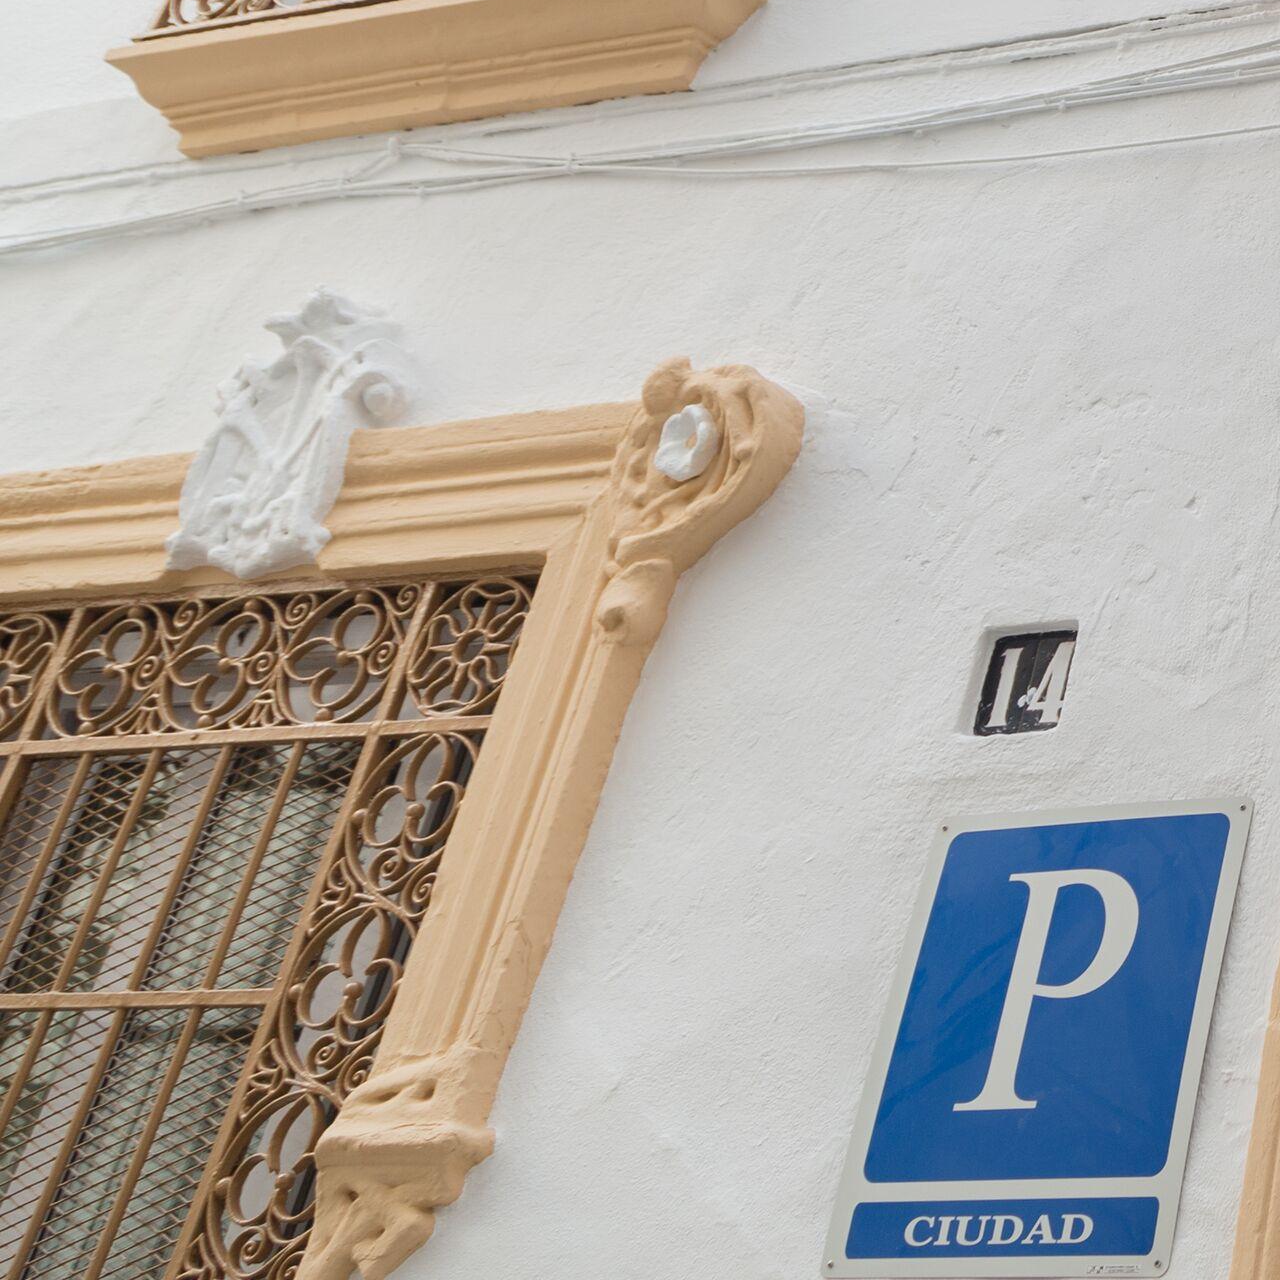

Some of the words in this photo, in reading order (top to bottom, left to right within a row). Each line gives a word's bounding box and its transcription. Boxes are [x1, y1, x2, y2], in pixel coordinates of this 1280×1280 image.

[984, 640, 1077, 728] 14
[952, 867, 1140, 1112] P
[903, 1212, 1095, 1248] CIUDAD
